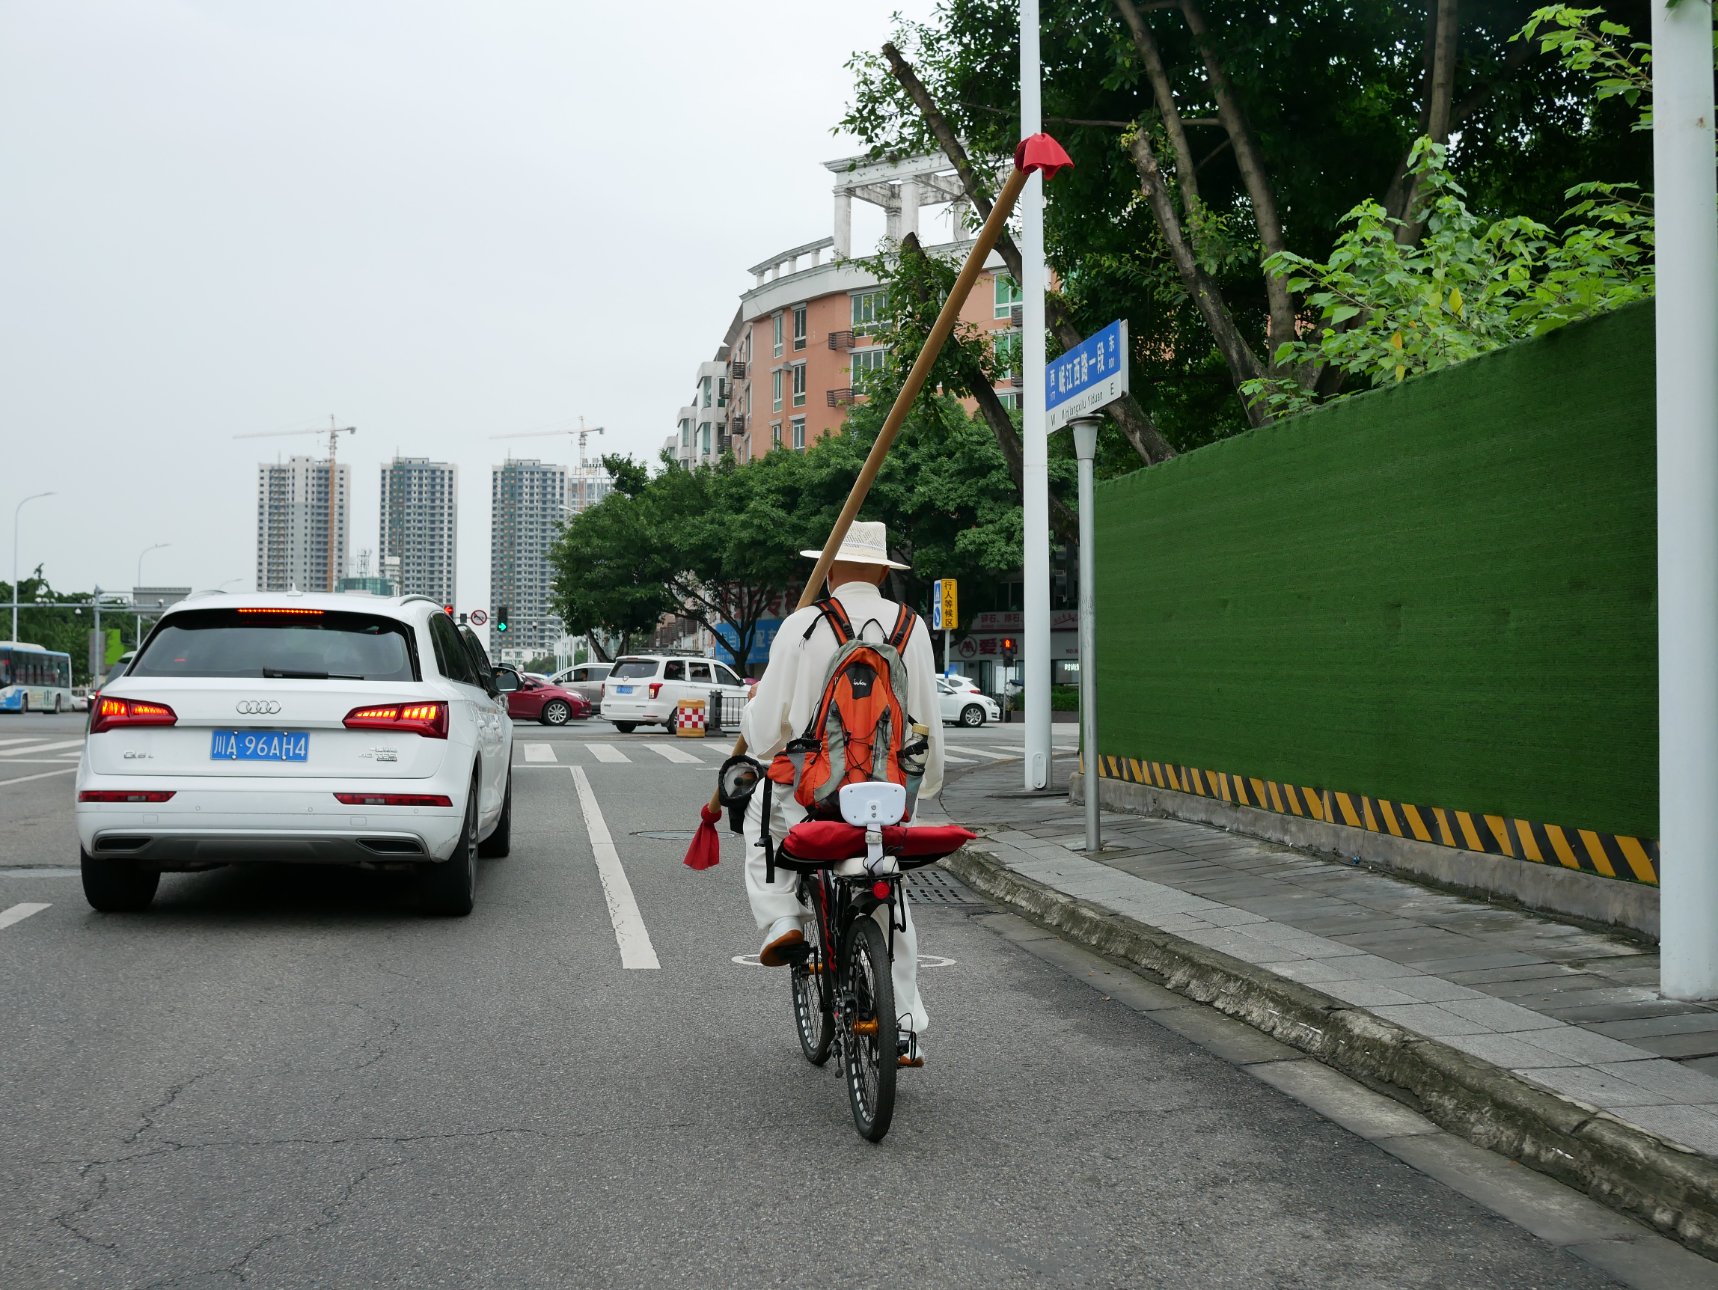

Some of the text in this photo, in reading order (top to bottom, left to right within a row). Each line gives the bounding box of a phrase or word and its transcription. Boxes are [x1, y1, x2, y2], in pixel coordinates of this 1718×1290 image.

[1110, 382, 1115, 396] E
[944, 581, 953, 627] 行人等候区
